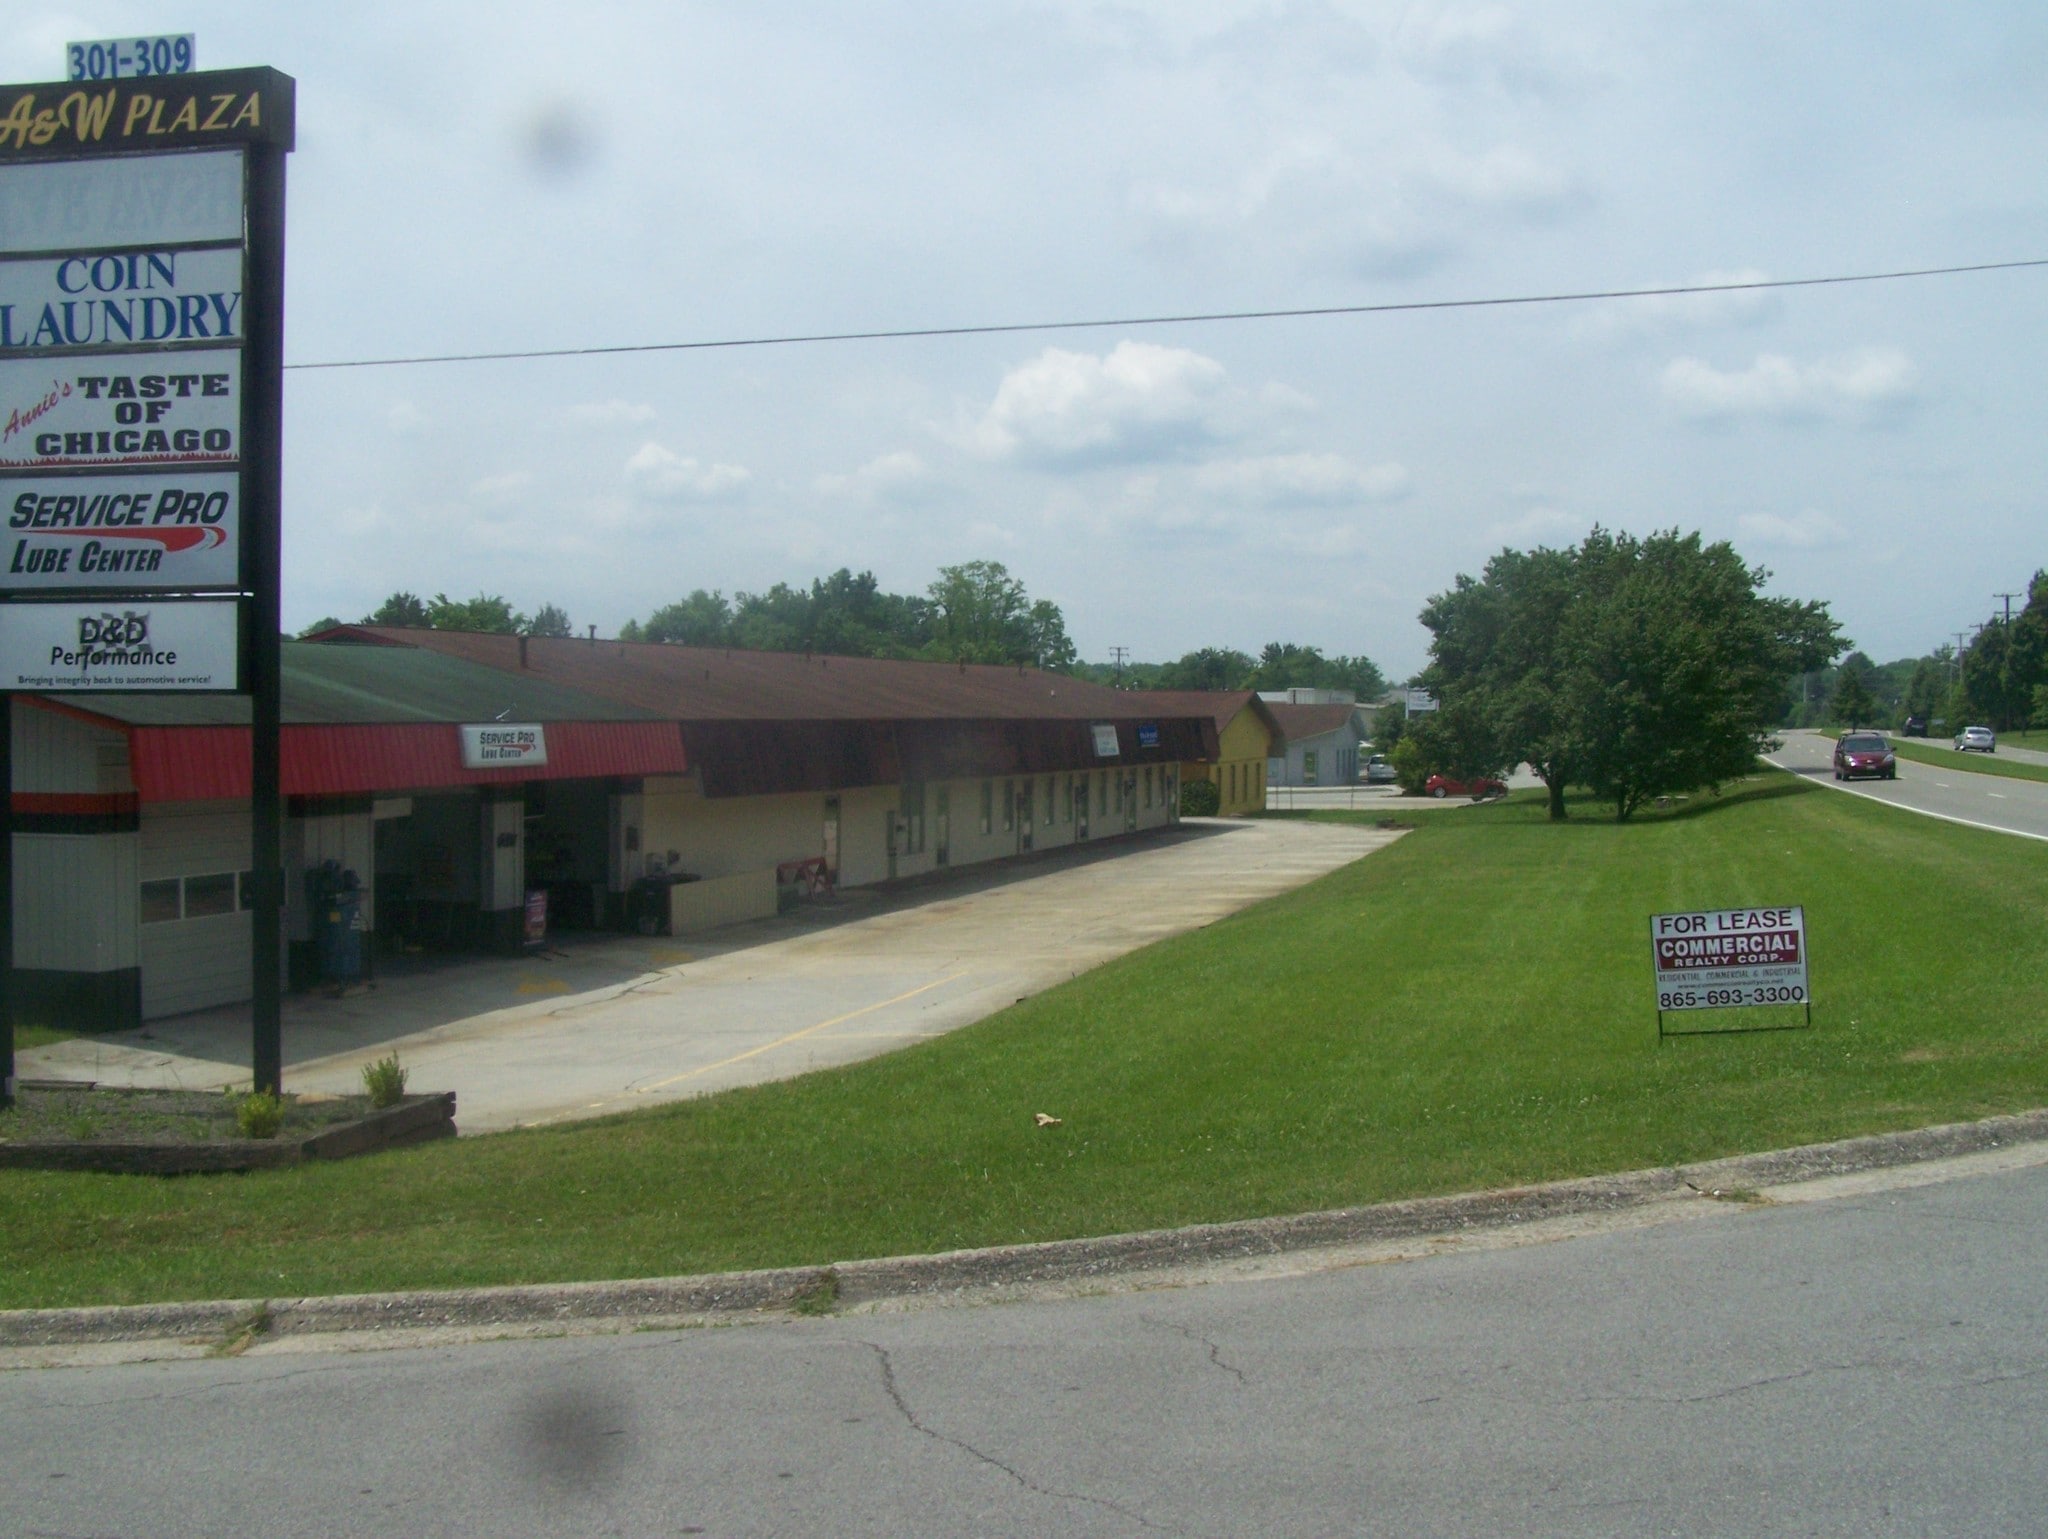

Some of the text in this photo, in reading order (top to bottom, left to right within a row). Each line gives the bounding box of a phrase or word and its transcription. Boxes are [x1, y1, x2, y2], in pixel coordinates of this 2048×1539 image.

[69, 37, 192, 81] 301-309
[0, 88, 261, 149] A&W PLAZA
[56, 253, 176, 294] COIN
[0, 292, 242, 346] LAUNDRY
[77, 374, 230, 399] TASTE
[3, 380, 73, 443] Annie's
[115, 401, 172, 424] OF
[35, 429, 231, 456] CHICAGO
[9, 489, 230, 528] SERVICE PRO
[9, 539, 163, 574] LUBE CENTER
[79, 617, 148, 645] D&D
[50, 646, 177, 670] Performance
[18, 674, 212, 686] Bringing integrity back to automotive service!
[480, 731, 535, 744] SERVICE PRO
[1660, 910, 1793, 934] FOR LEASE
[1661, 934, 1796, 957] COMMERCIAL
[1674, 952, 1784, 967] REALTY CORP.
[1660, 986, 1804, 1007] 865-693-3300
